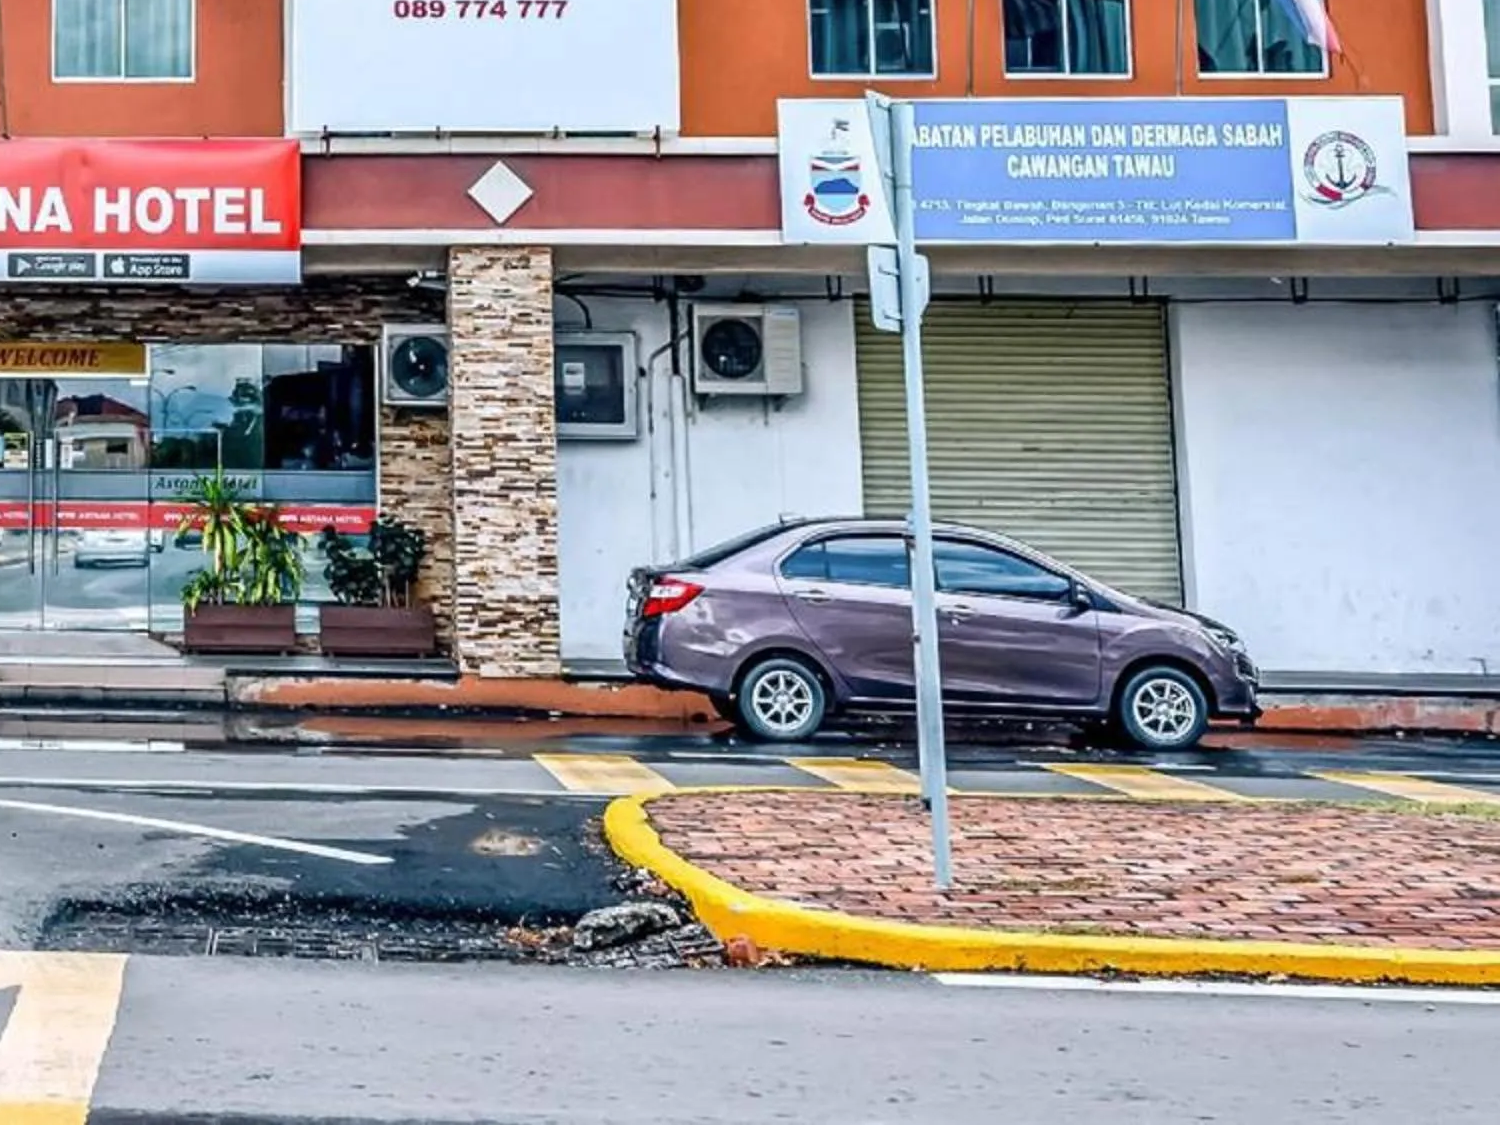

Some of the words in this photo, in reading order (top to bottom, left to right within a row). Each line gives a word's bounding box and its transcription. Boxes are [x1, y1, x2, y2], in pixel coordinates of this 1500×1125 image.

[393, 0, 446, 19] 089
[455, 0, 507, 19] 774
[517, 0, 568, 19] 777
[981, 124, 1086, 148] PELABUHAN
[1091, 124, 1128, 148] DAN
[1131, 124, 1218, 148] DERMAGA
[1222, 123, 1284, 147] SABAH
[1007, 154, 1109, 178] CAWANGAN
[1112, 154, 1176, 177] TAWAU
[93, 185, 282, 235] HOTEL
[130, 265, 152, 277] App
[154, 264, 184, 276] Store
[154, 476, 200, 491] Astan
